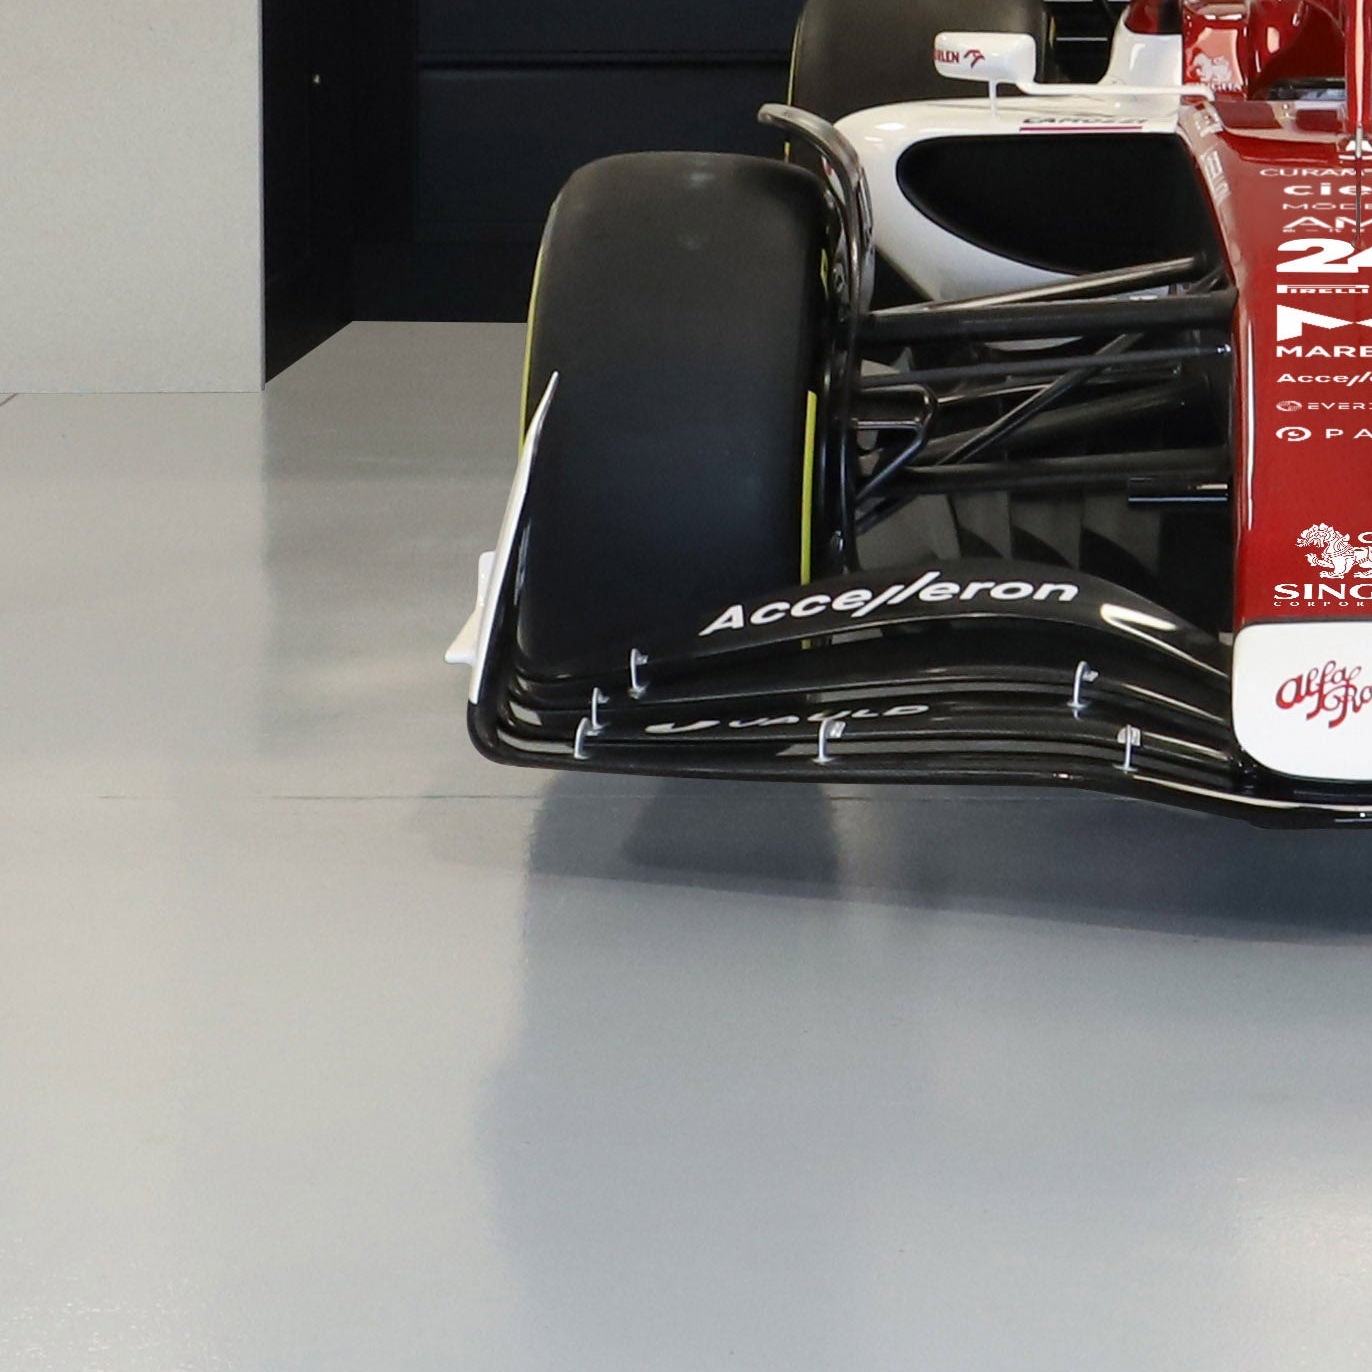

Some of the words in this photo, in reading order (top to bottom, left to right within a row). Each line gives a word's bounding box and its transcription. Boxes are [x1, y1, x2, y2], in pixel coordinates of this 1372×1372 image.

[1276, 284, 1370, 294] PIRELLI
[699, 570, 1079, 636] Accelleron
[1275, 659, 1350, 721] Alfa
